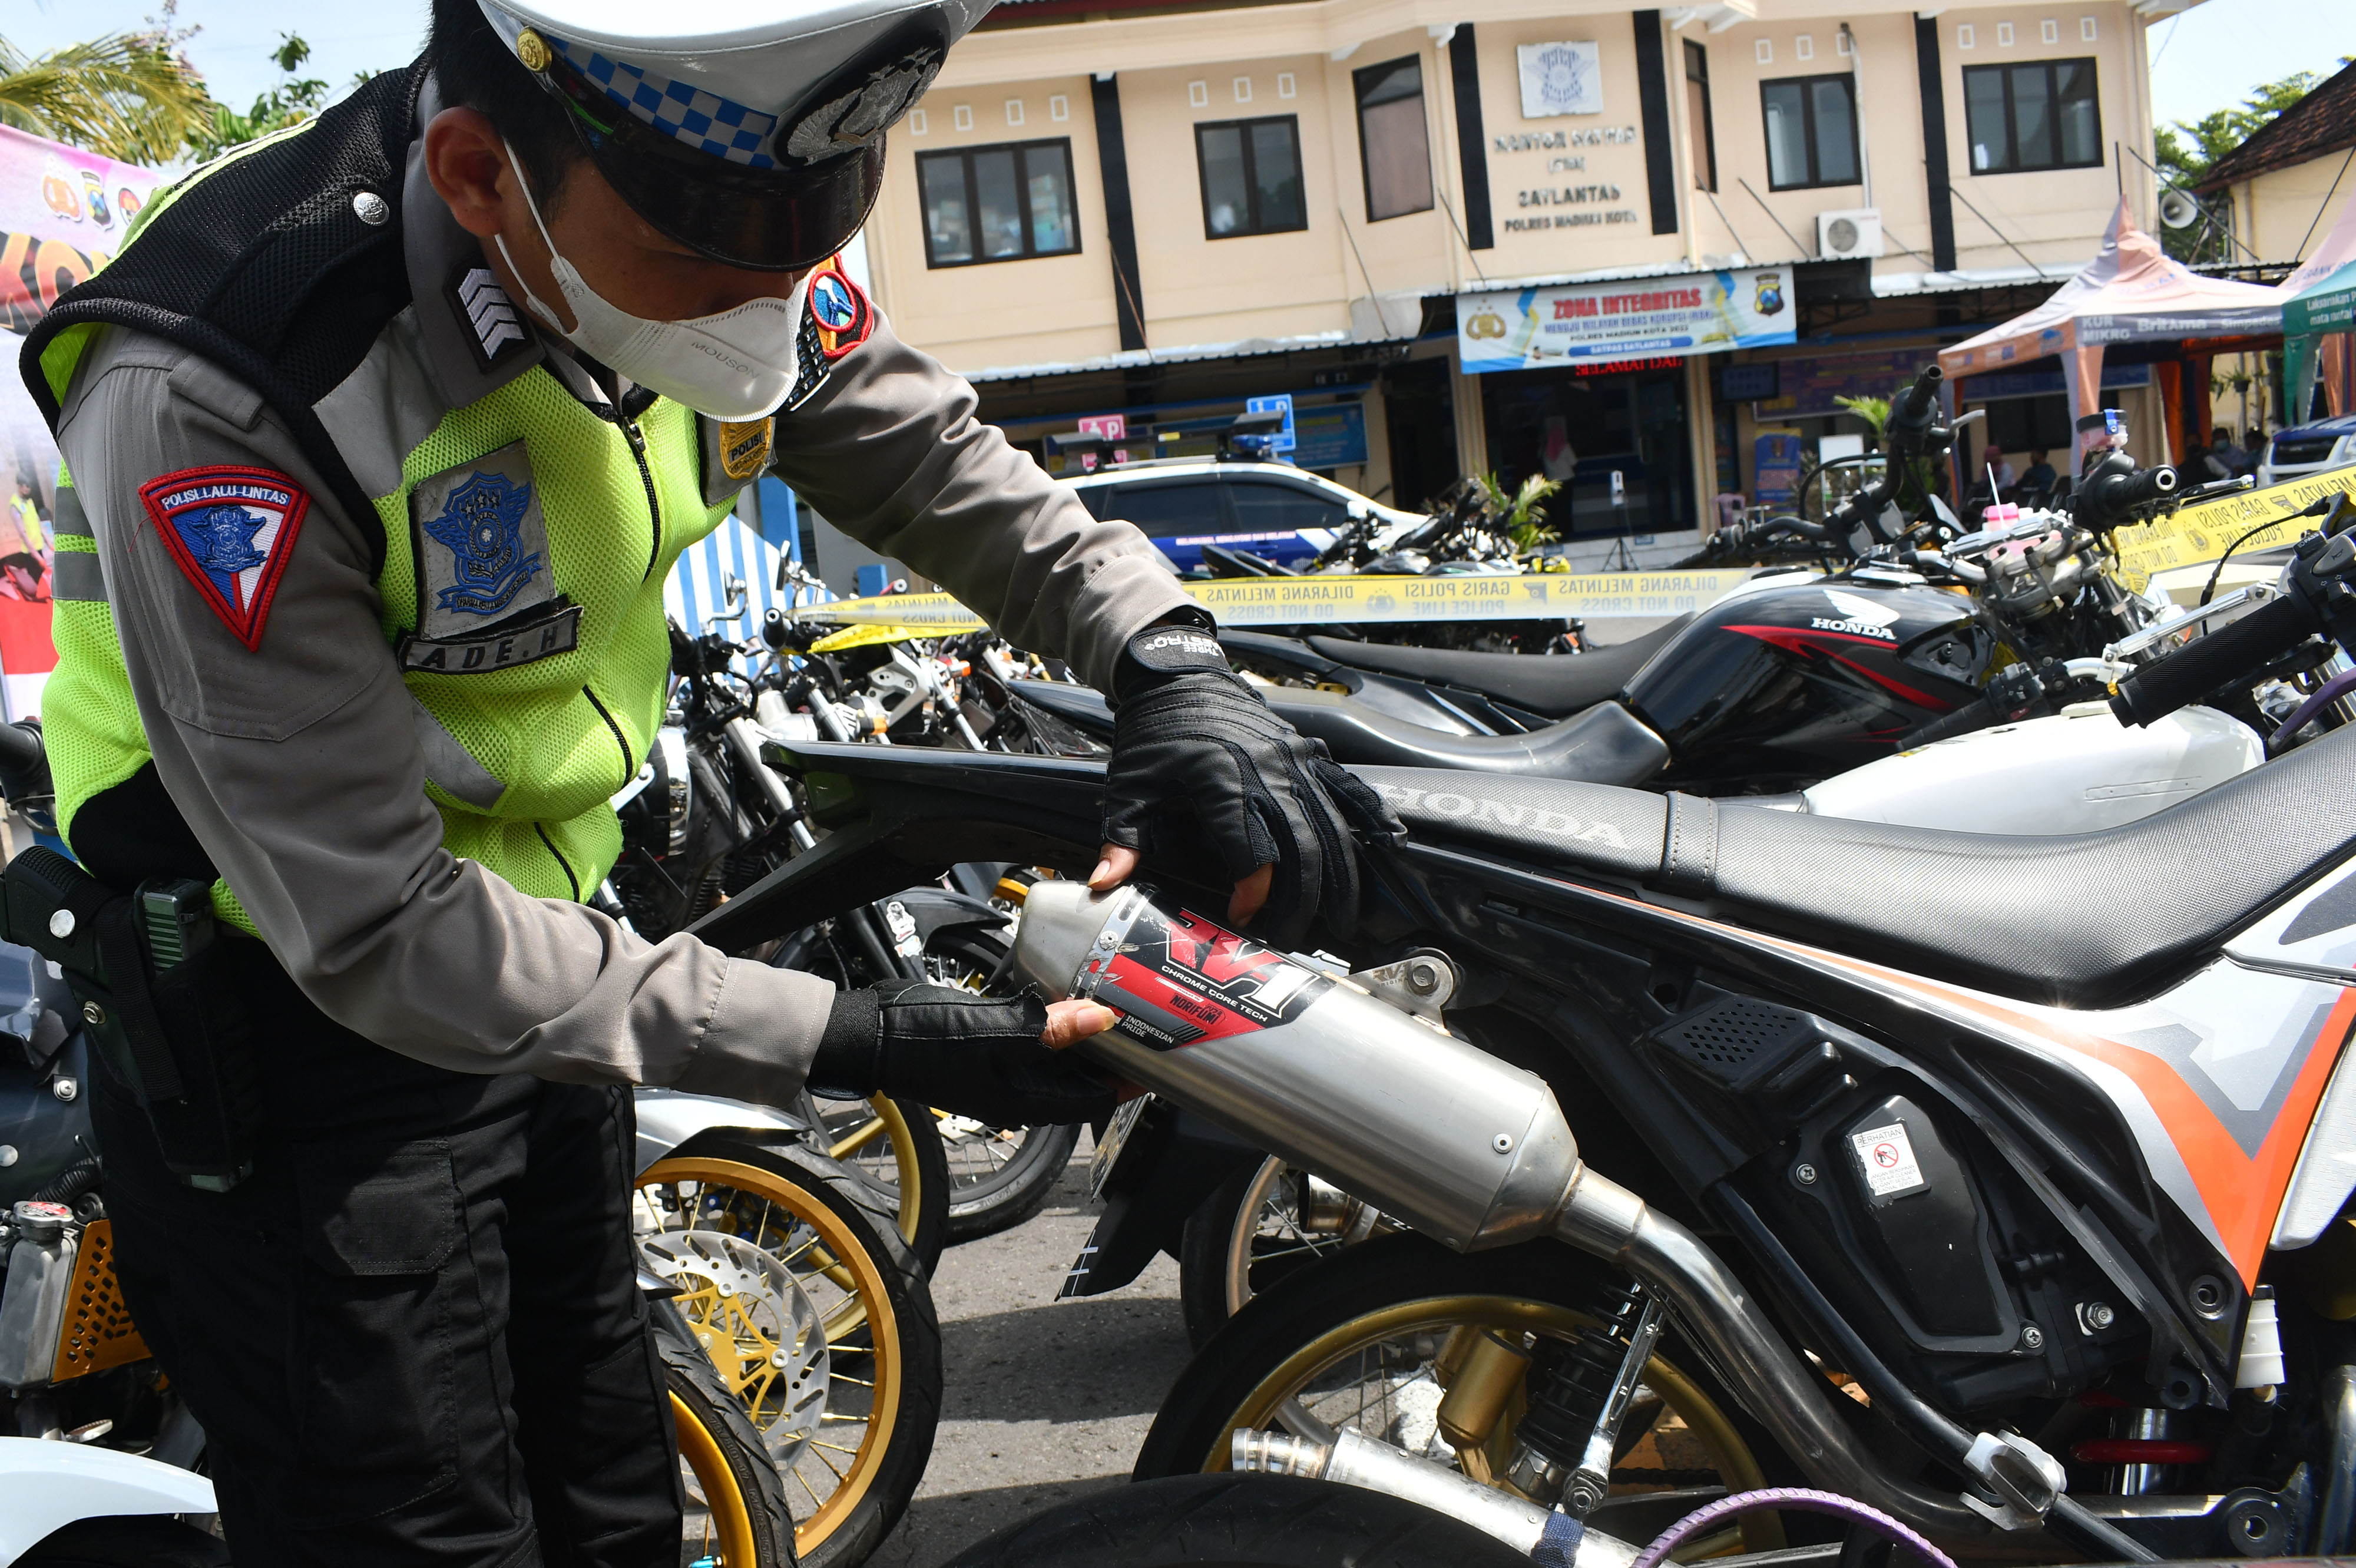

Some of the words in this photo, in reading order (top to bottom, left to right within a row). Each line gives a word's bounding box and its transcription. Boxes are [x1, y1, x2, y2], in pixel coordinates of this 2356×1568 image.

[1518, 184, 1621, 207] SATLANTAS
[1505, 217, 1551, 231] POLRES
[1553, 297, 1599, 319] ZONA
[1602, 289, 1702, 315] INTEGRITAS
[2082, 316, 2115, 329] KUR
[2083, 328, 2130, 342] MIKRO
[691, 342, 760, 379] MOUSON
[732, 433, 766, 462] POLISI
[162, 489, 200, 510] POLISI
[202, 485, 236, 499] LALU
[242, 485, 288, 505] LINTAS
[2304, 532, 2319, 545] PASS
[1811, 617, 1897, 640] HONDA
[1183, 643, 1219, 657] THREE
[1370, 783, 1633, 850] HONDA
[1161, 964, 1206, 992] CHROME
[1208, 988, 1239, 1007] CORE
[1240, 1003, 1268, 1023] TECH
[1169, 995, 1220, 1025] NORIFUMI
[1121, 1021, 1147, 1038] PRIDE
[1124, 1014, 1174, 1045] INDONESIAN
[1857, 1128, 1902, 1146] PERHATIAN
